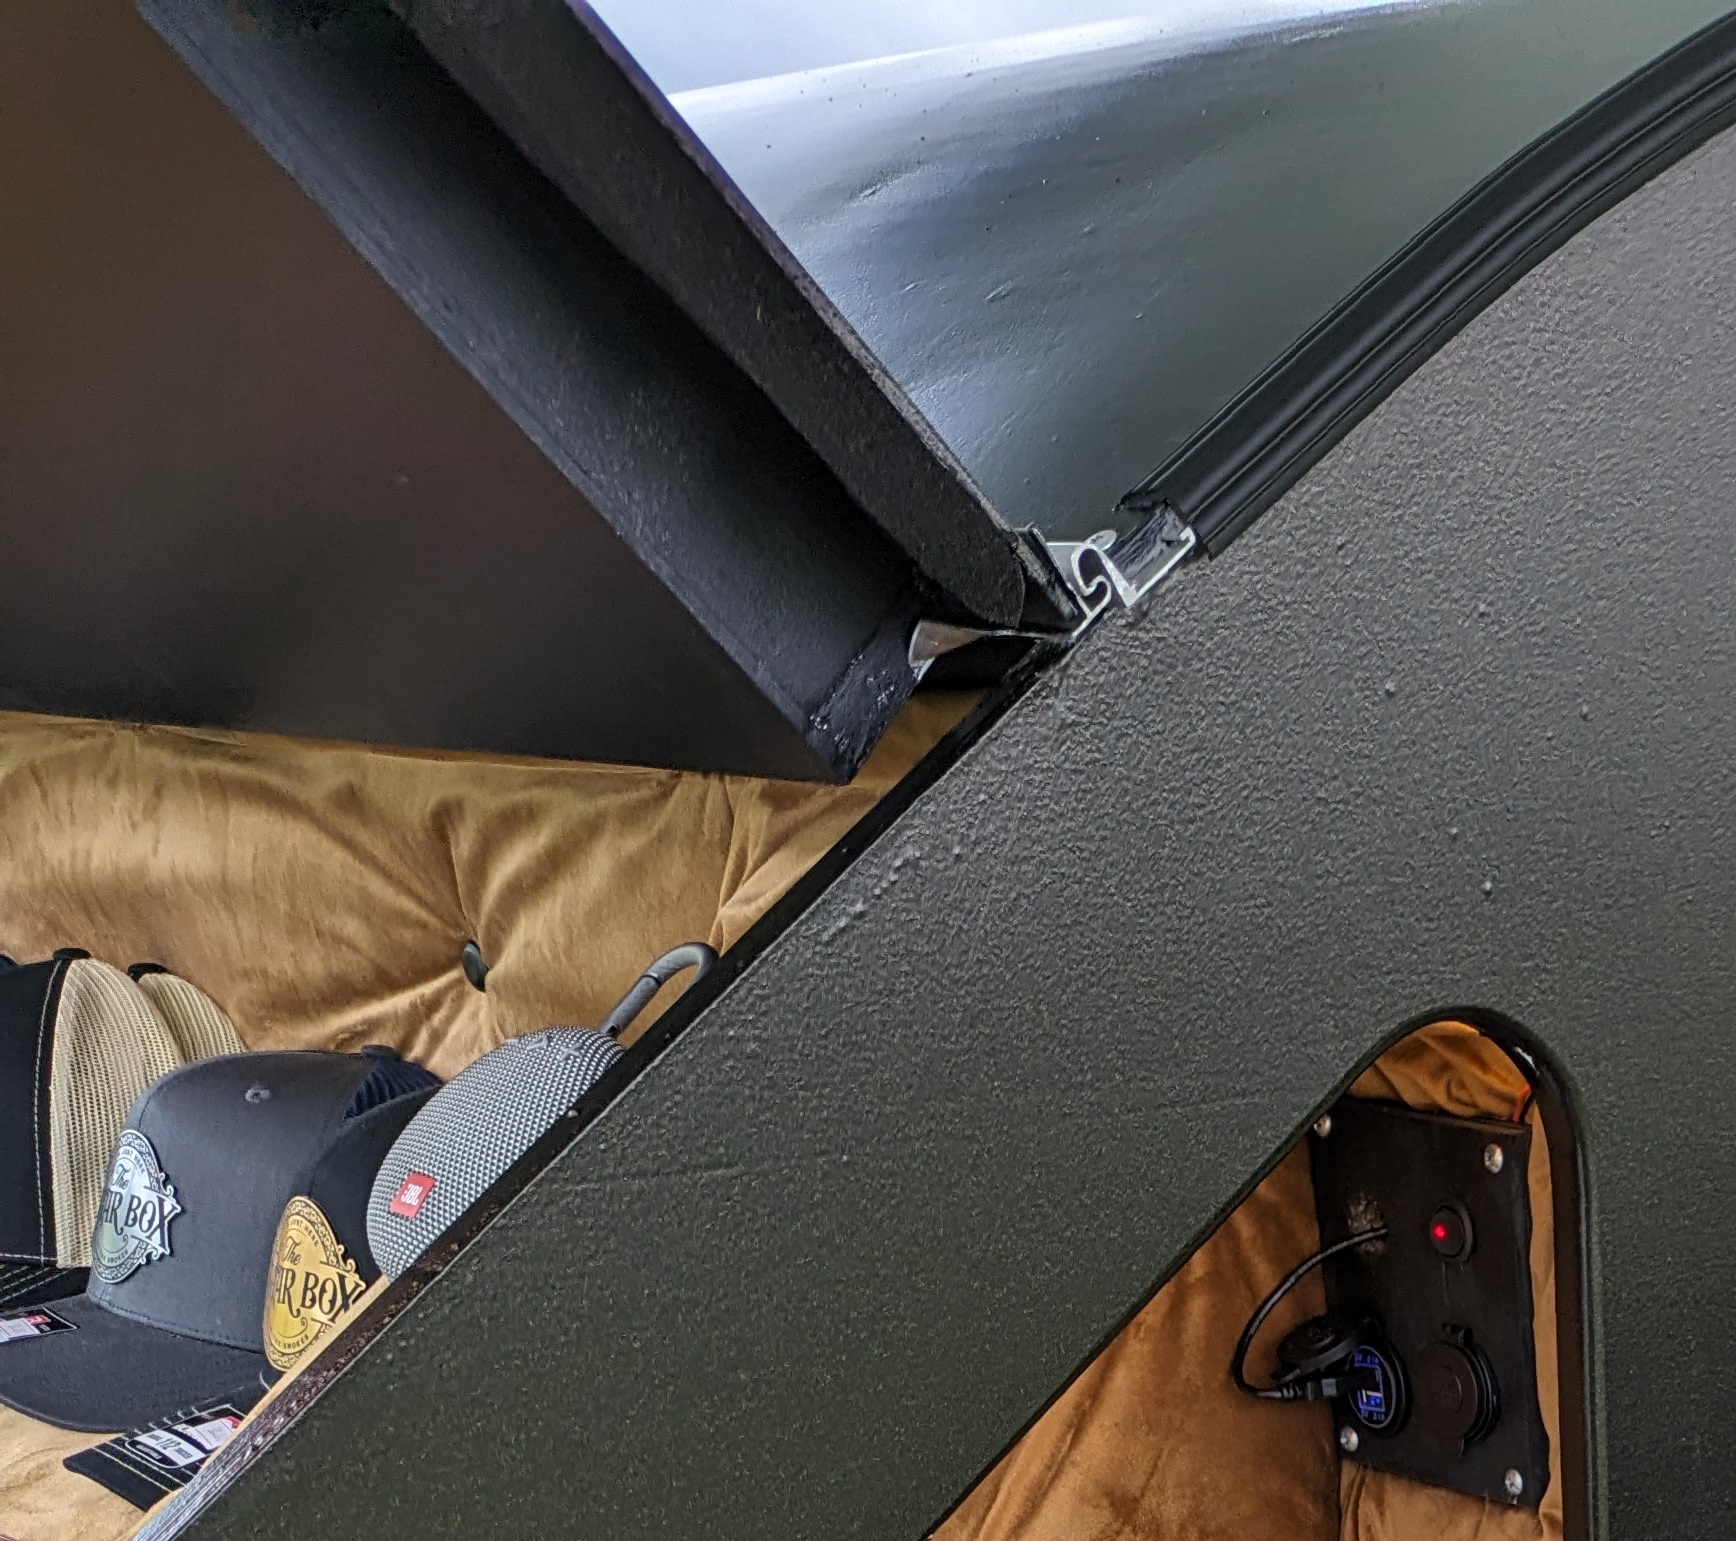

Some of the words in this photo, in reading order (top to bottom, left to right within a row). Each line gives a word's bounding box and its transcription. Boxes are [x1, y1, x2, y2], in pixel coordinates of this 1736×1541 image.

[111, 1163, 131, 1190] The
[401, 1183, 423, 1206] JBL
[124, 1194, 179, 1250] BOX
[282, 1235, 302, 1266] The
[301, 1270, 363, 1324] BOX
